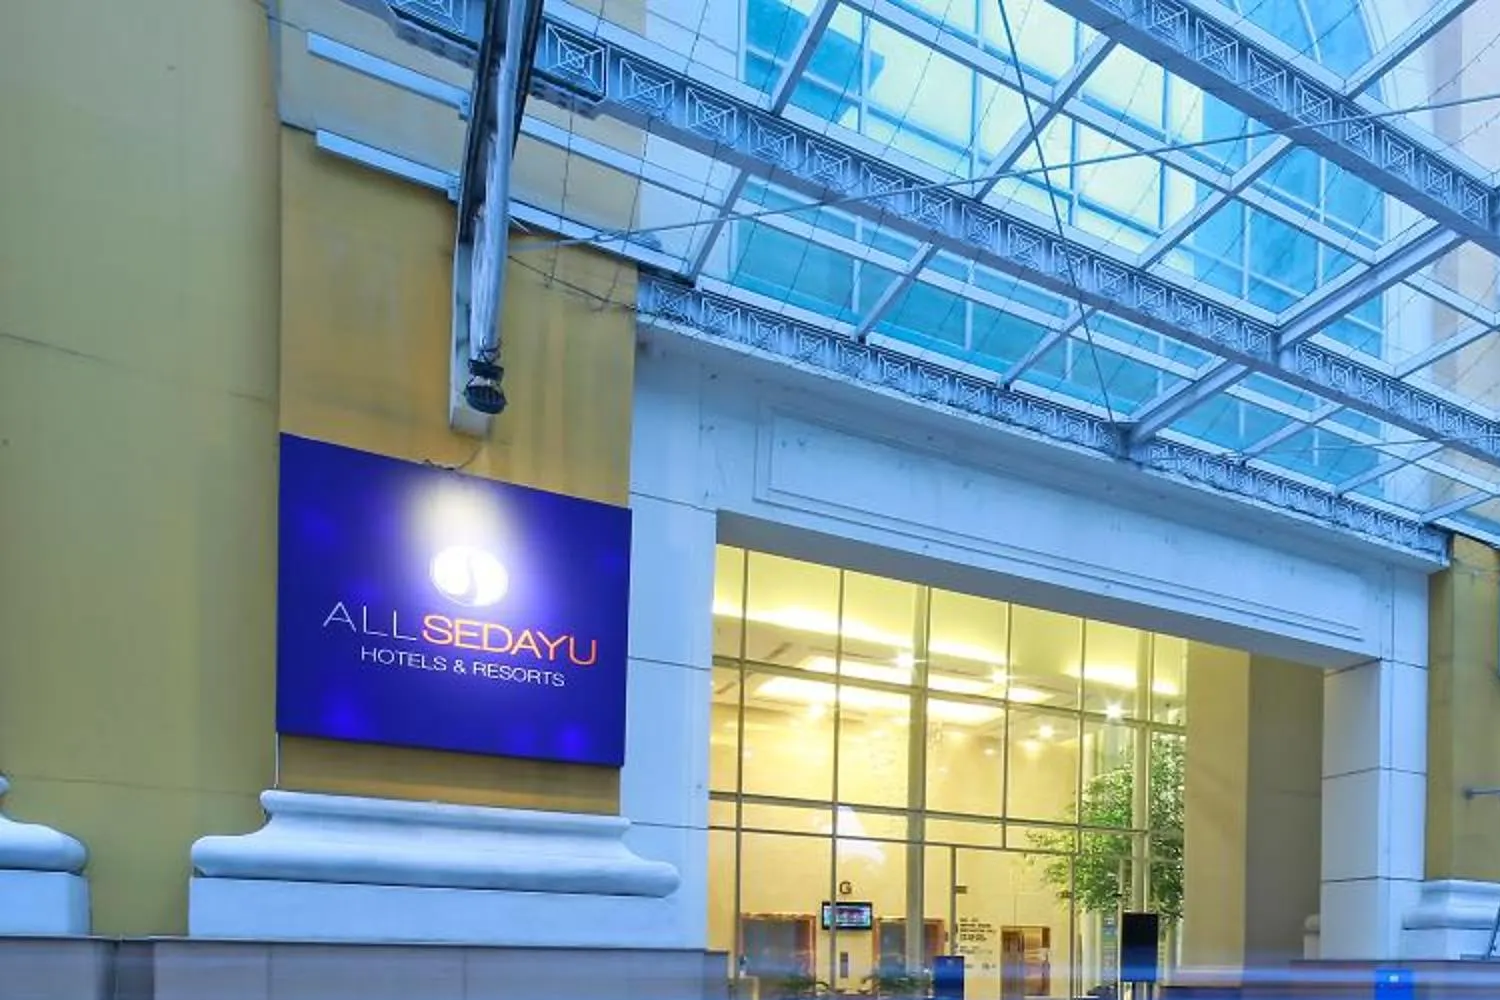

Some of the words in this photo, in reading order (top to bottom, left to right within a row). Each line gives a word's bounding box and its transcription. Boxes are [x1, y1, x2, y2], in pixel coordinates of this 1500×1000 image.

[360, 645, 447, 672] HOTELS
[453, 659, 467, 676] &
[473, 660, 566, 687] RESORTS
[839, 881, 852, 894] G
